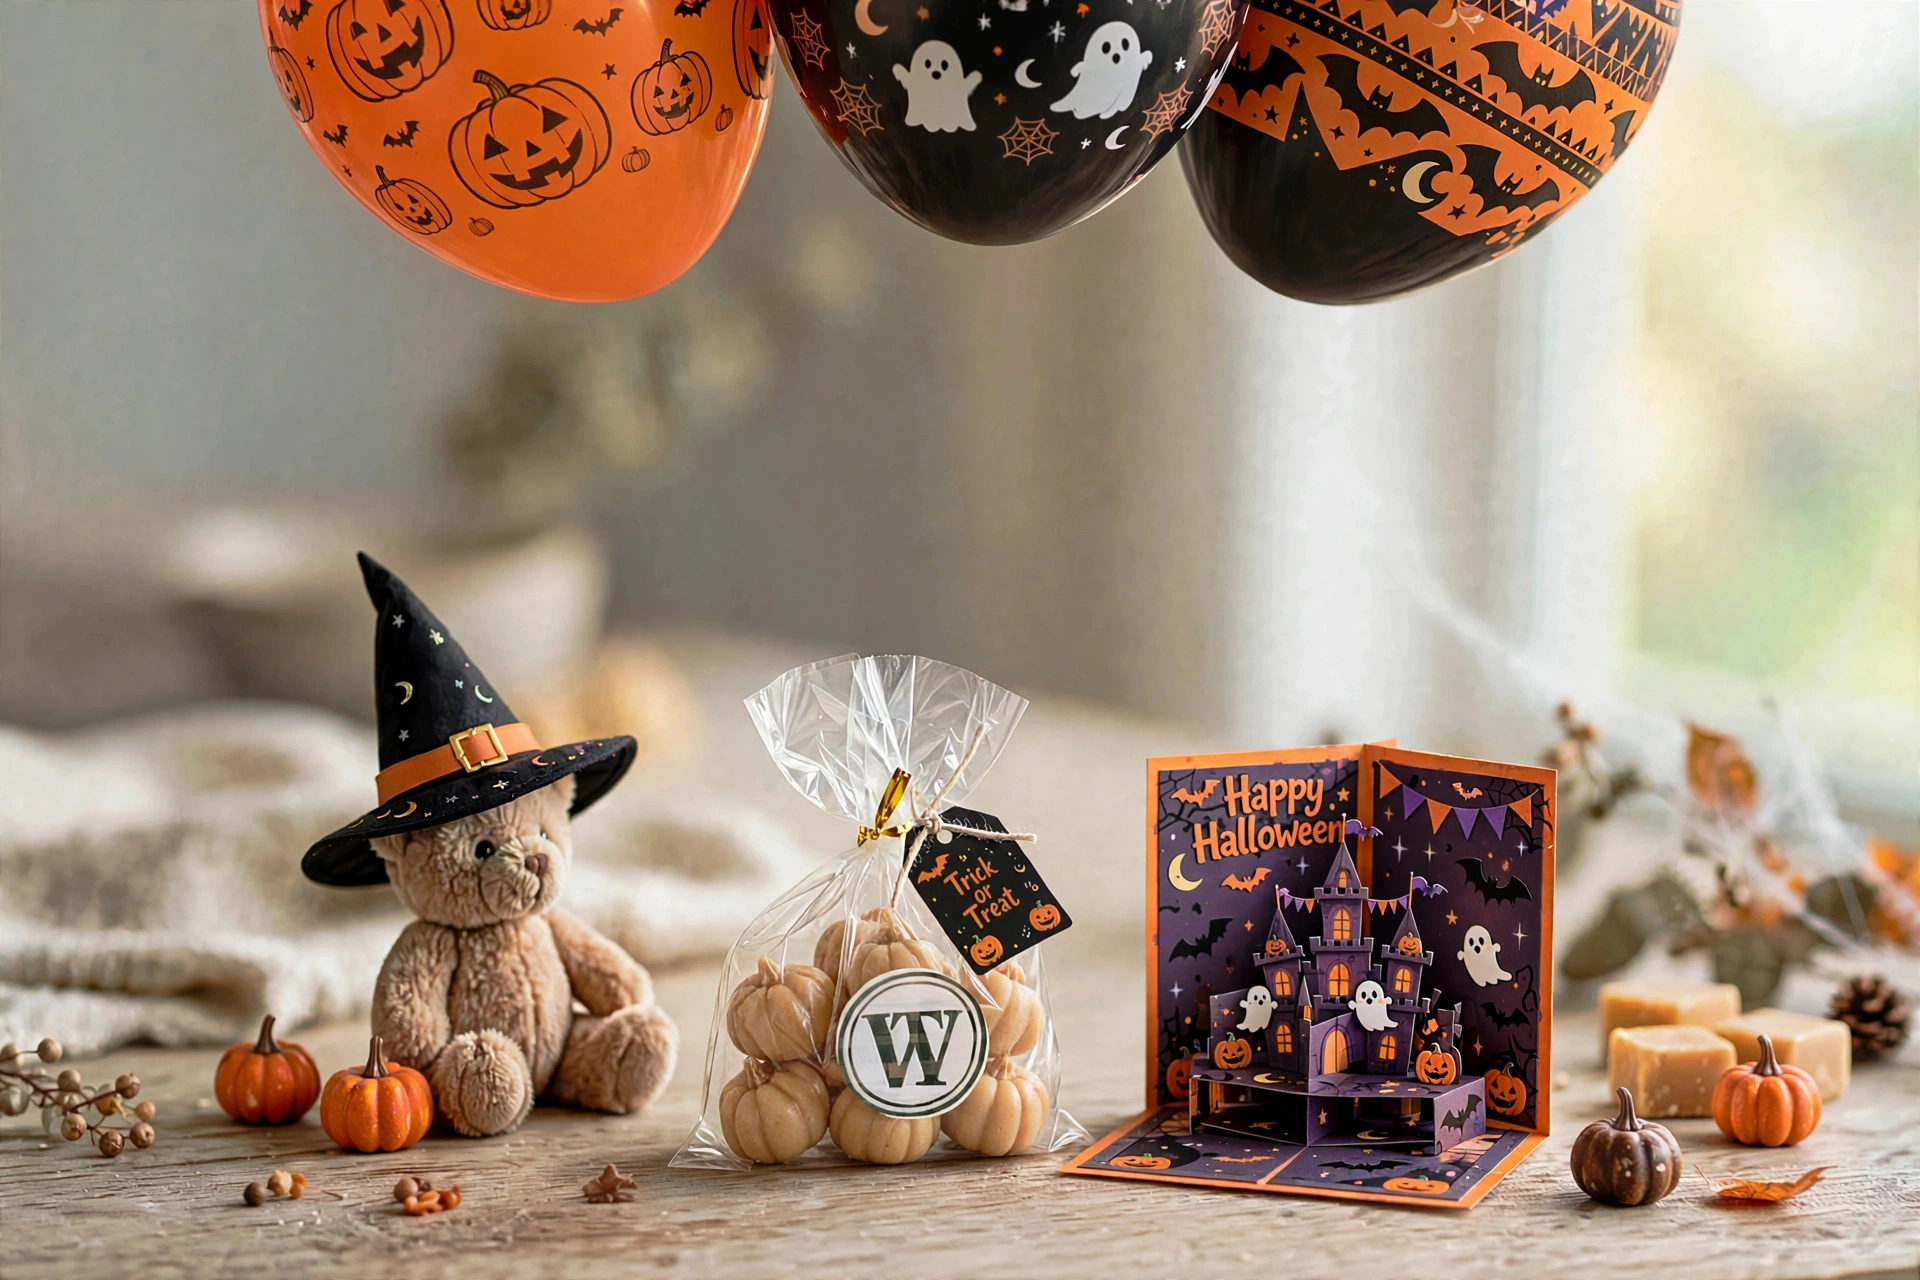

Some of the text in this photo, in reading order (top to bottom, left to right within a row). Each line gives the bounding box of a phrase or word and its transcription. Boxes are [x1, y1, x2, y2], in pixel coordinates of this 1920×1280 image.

[1223, 774, 1324, 817] Happy
[1192, 815, 1344, 864] Halloween
[943, 856, 999, 896] Trick
[974, 884, 992, 904] or
[962, 886, 1020, 929] Treat
